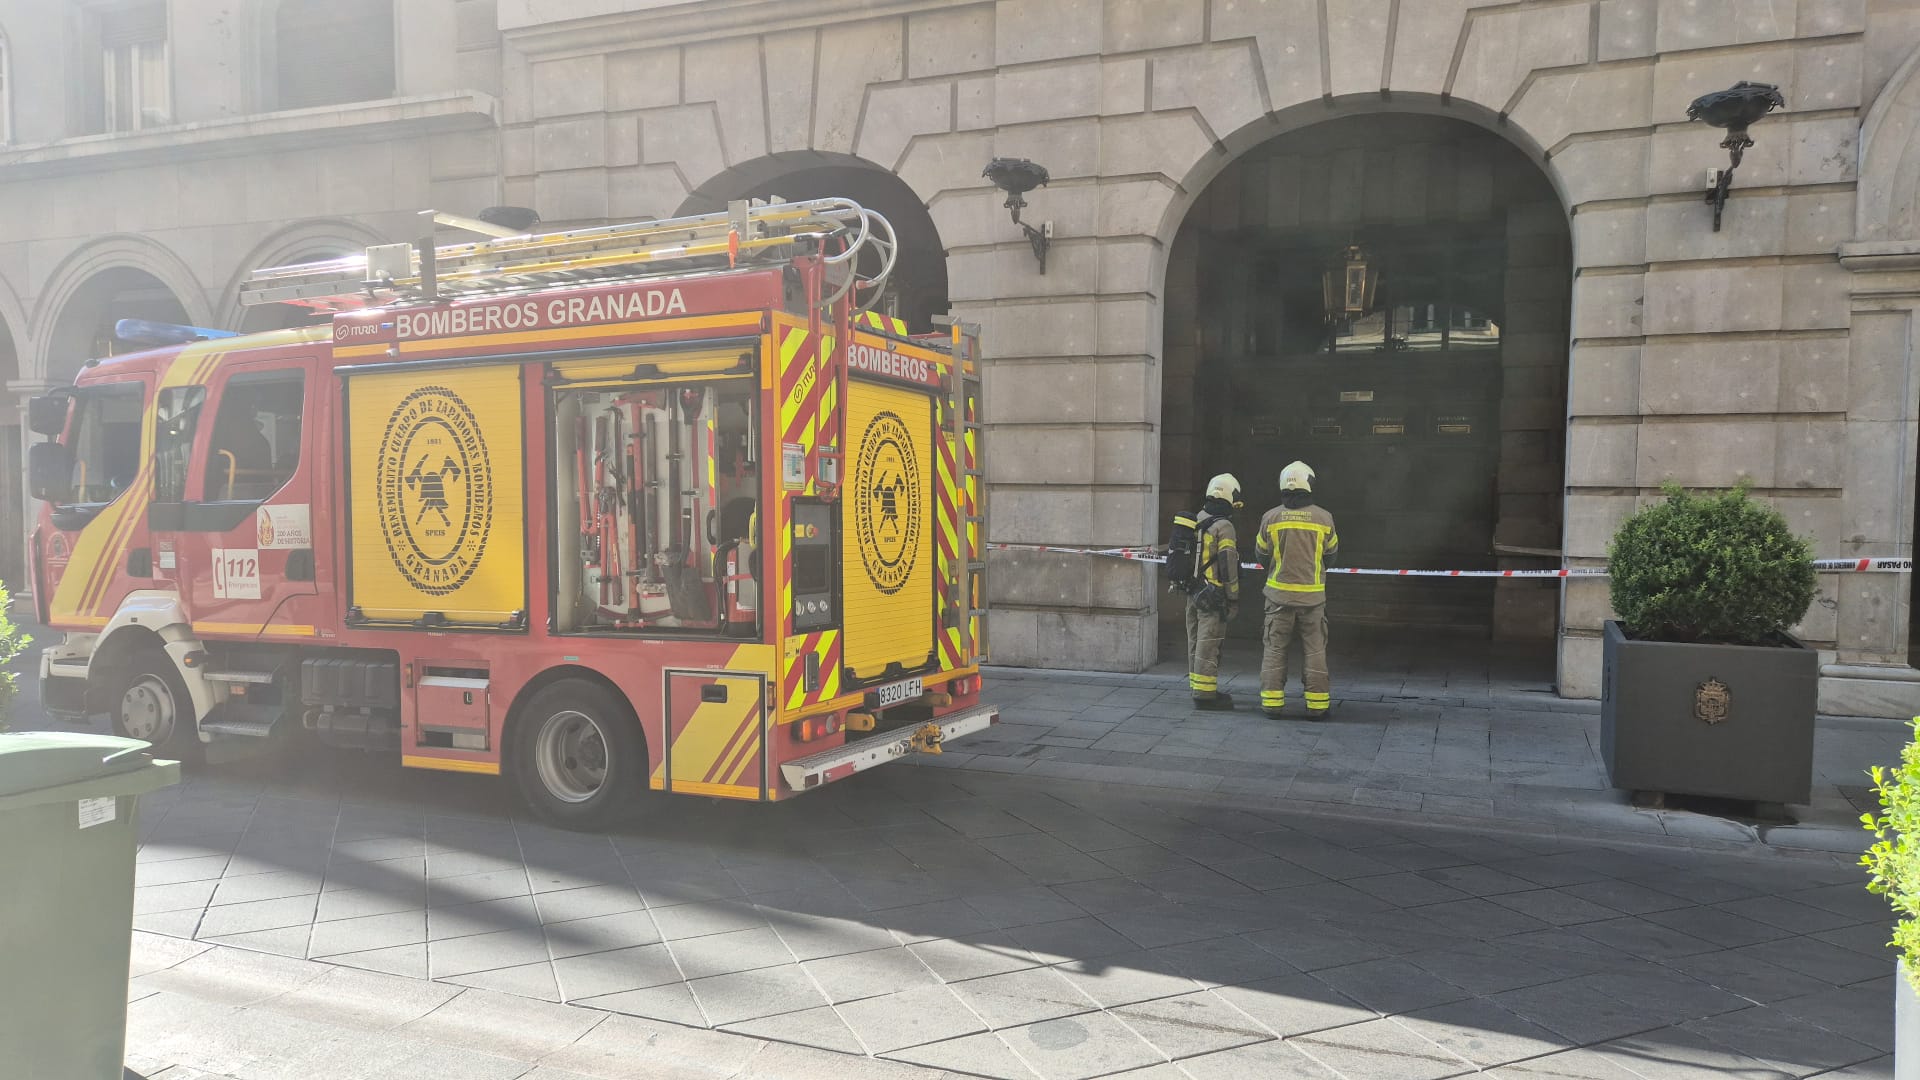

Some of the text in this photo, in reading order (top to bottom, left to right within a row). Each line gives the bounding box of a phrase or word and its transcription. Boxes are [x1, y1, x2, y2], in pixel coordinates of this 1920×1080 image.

[396, 288, 688, 338] BOMBEROS GRANADA
[848, 344, 928, 382] BOMBEROS
[385, 399, 485, 537] BENEMERITO CUERPO DE ZAPADORES BOMBEROS
[227, 558, 256, 578] 112
[405, 553, 468, 583] GRANADA
[871, 559, 908, 583] GRANADA
[1877, 561, 1902, 569] PASAR
[880, 679, 921, 704] 8320 LFH
